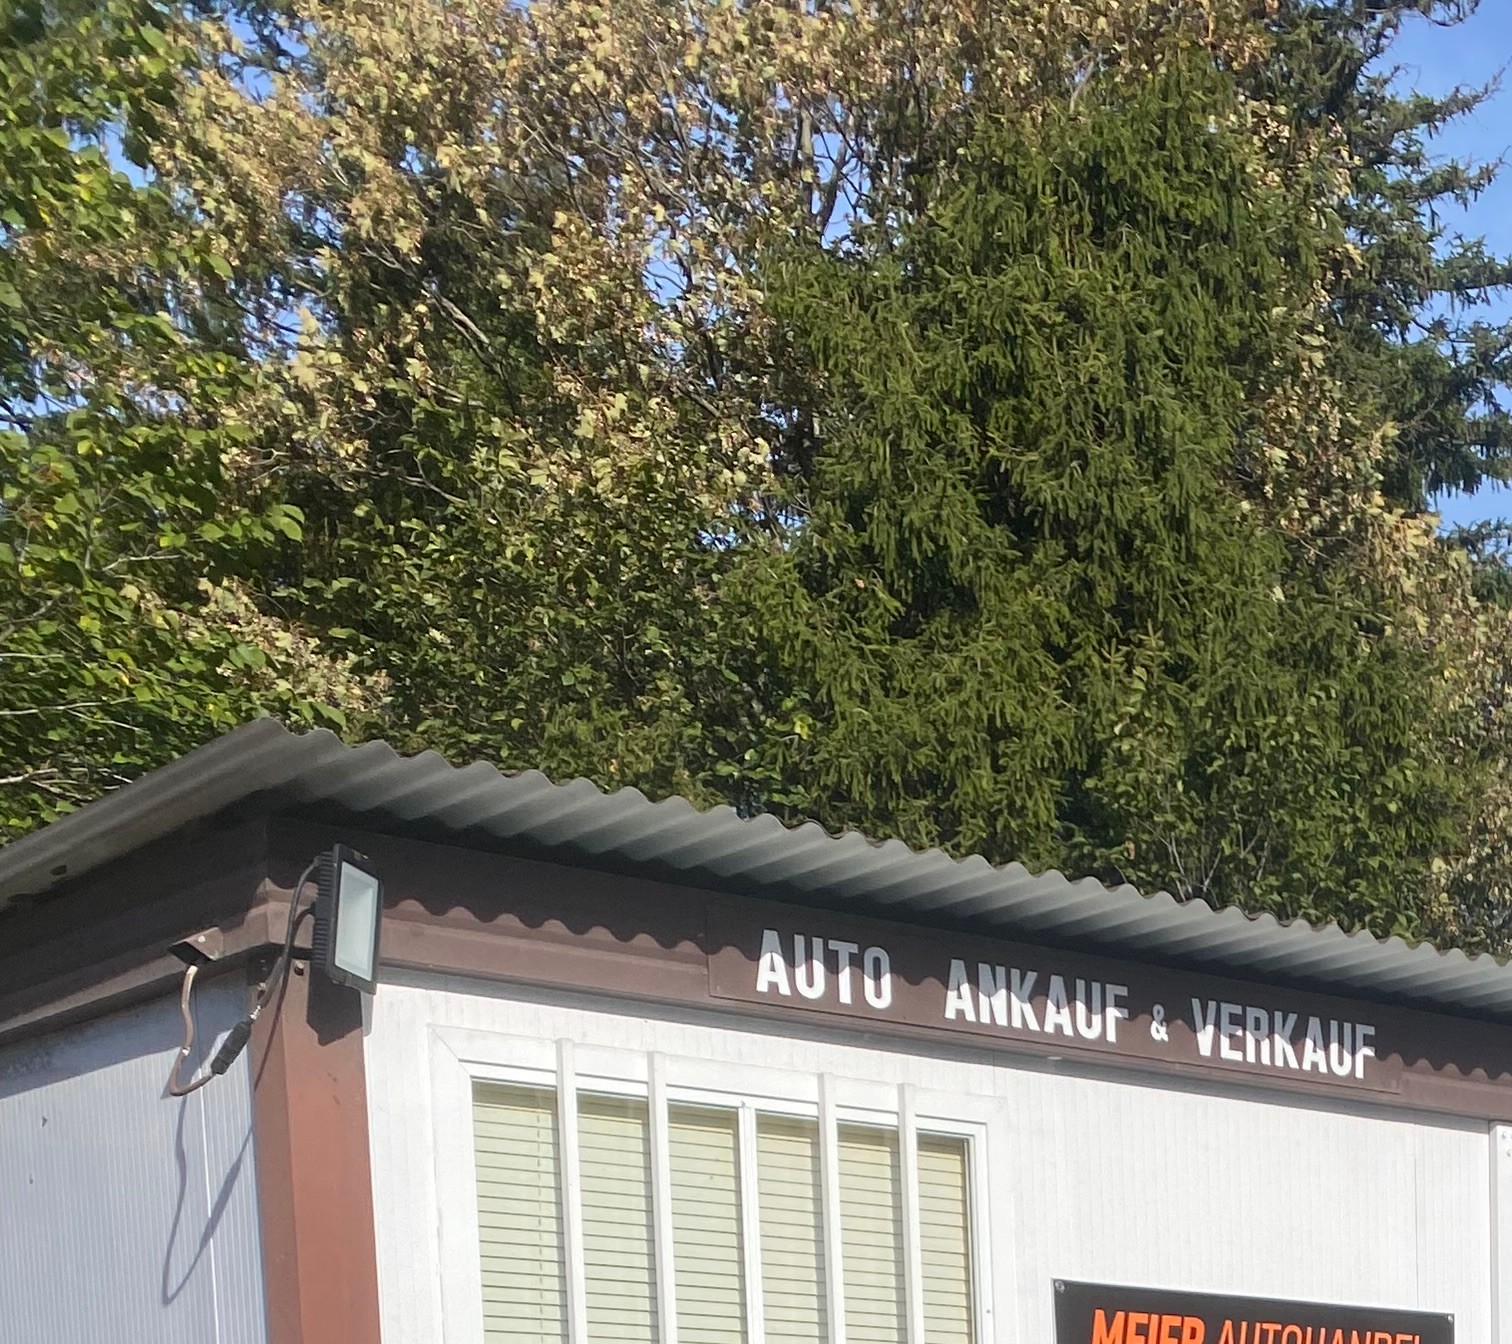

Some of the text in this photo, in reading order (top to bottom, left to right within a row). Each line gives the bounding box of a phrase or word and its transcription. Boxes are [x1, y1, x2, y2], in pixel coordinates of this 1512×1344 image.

[756, 929, 1376, 1079] AUTO ANKAUF & VERKAUF
